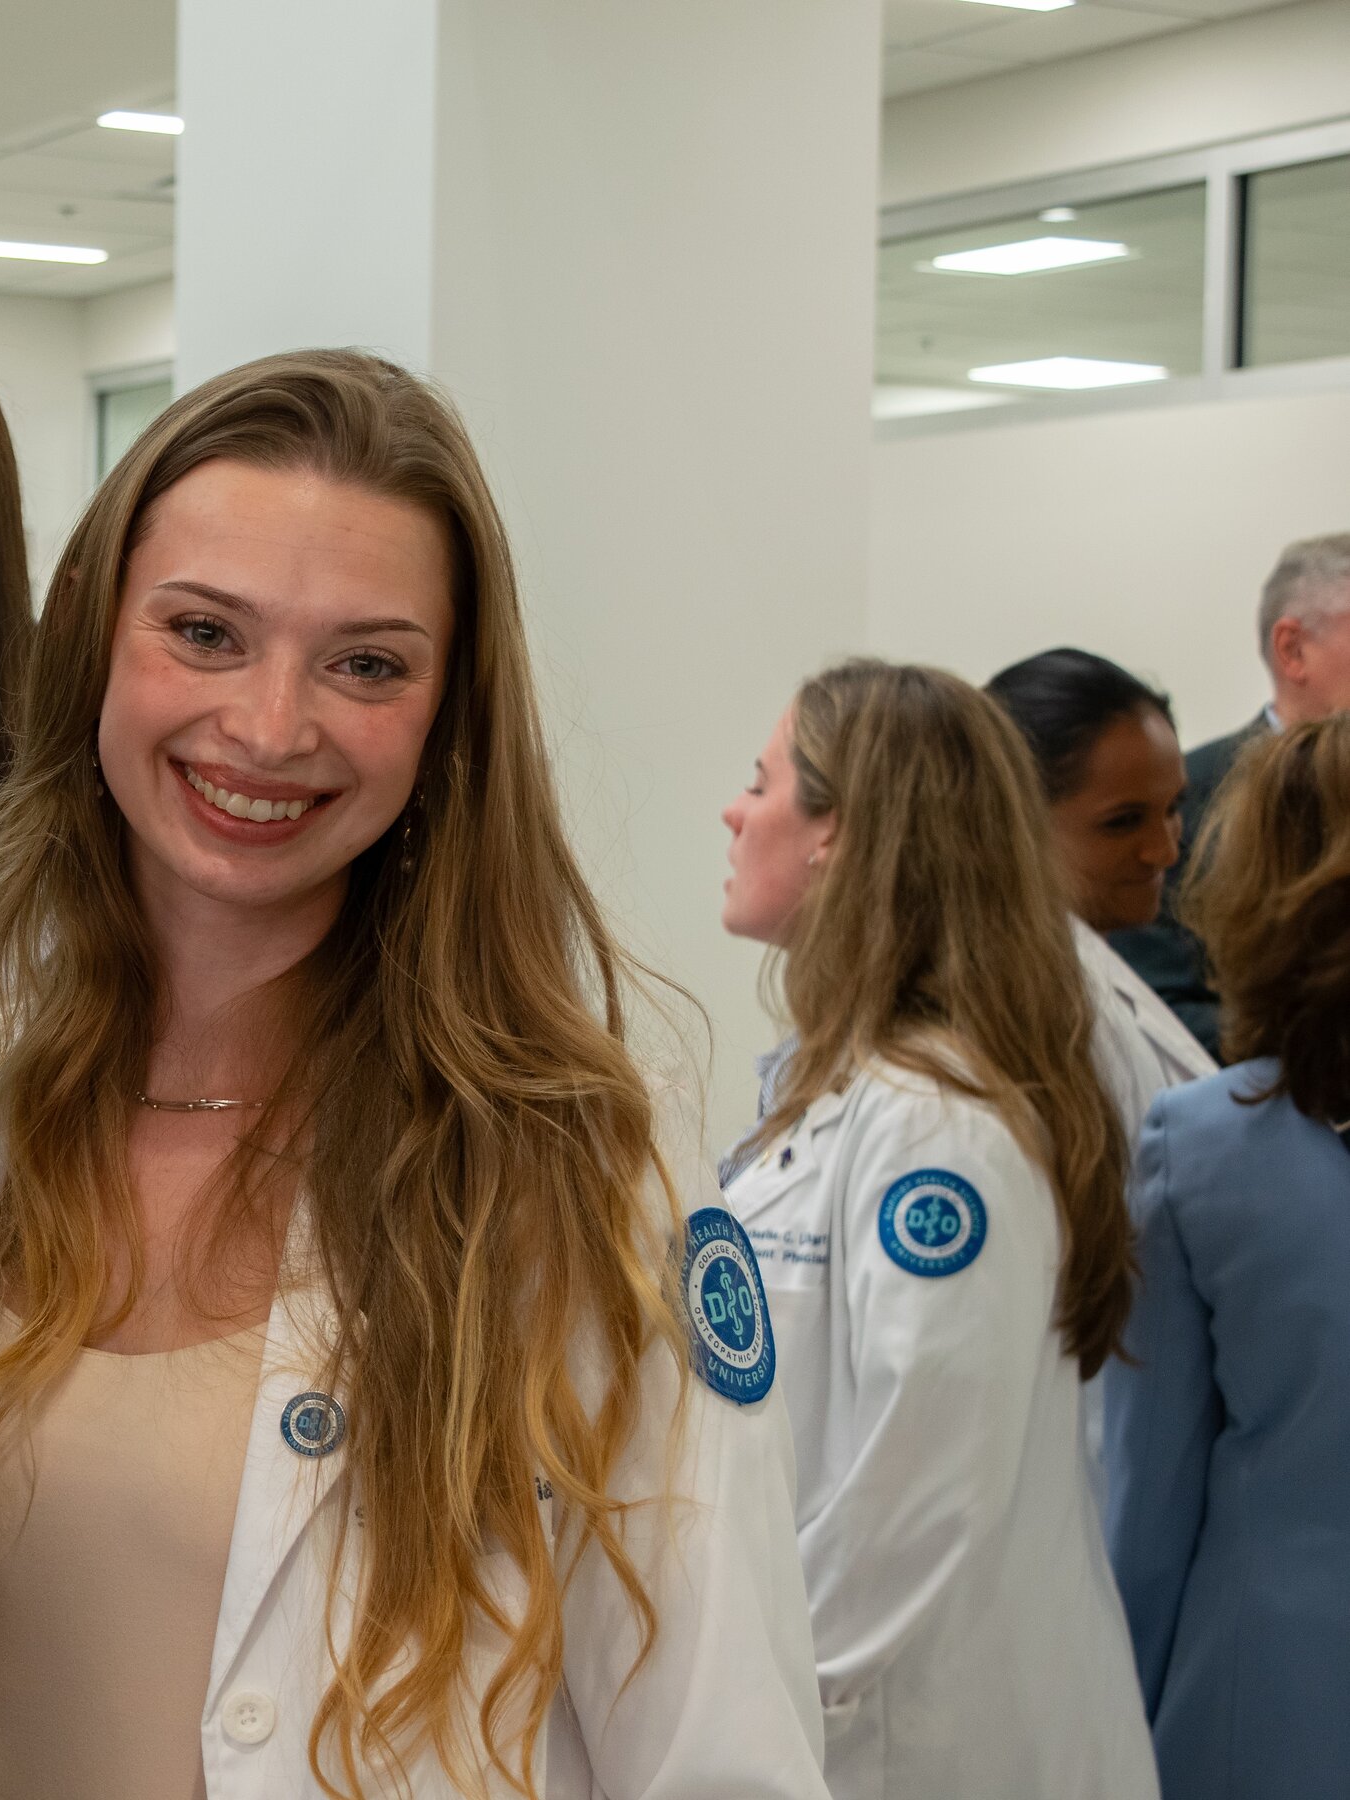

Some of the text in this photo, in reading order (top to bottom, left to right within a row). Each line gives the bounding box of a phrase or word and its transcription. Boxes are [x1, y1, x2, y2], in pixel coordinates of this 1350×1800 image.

[689, 1222, 730, 1250] HEALTH
[697, 1243, 731, 1271] COLLEGE
[731, 1249, 742, 1263] OF
[693, 1292, 763, 1364] OSTEOPATHIC MEDICINE
[706, 1336, 771, 1388] UNIVERSITY
